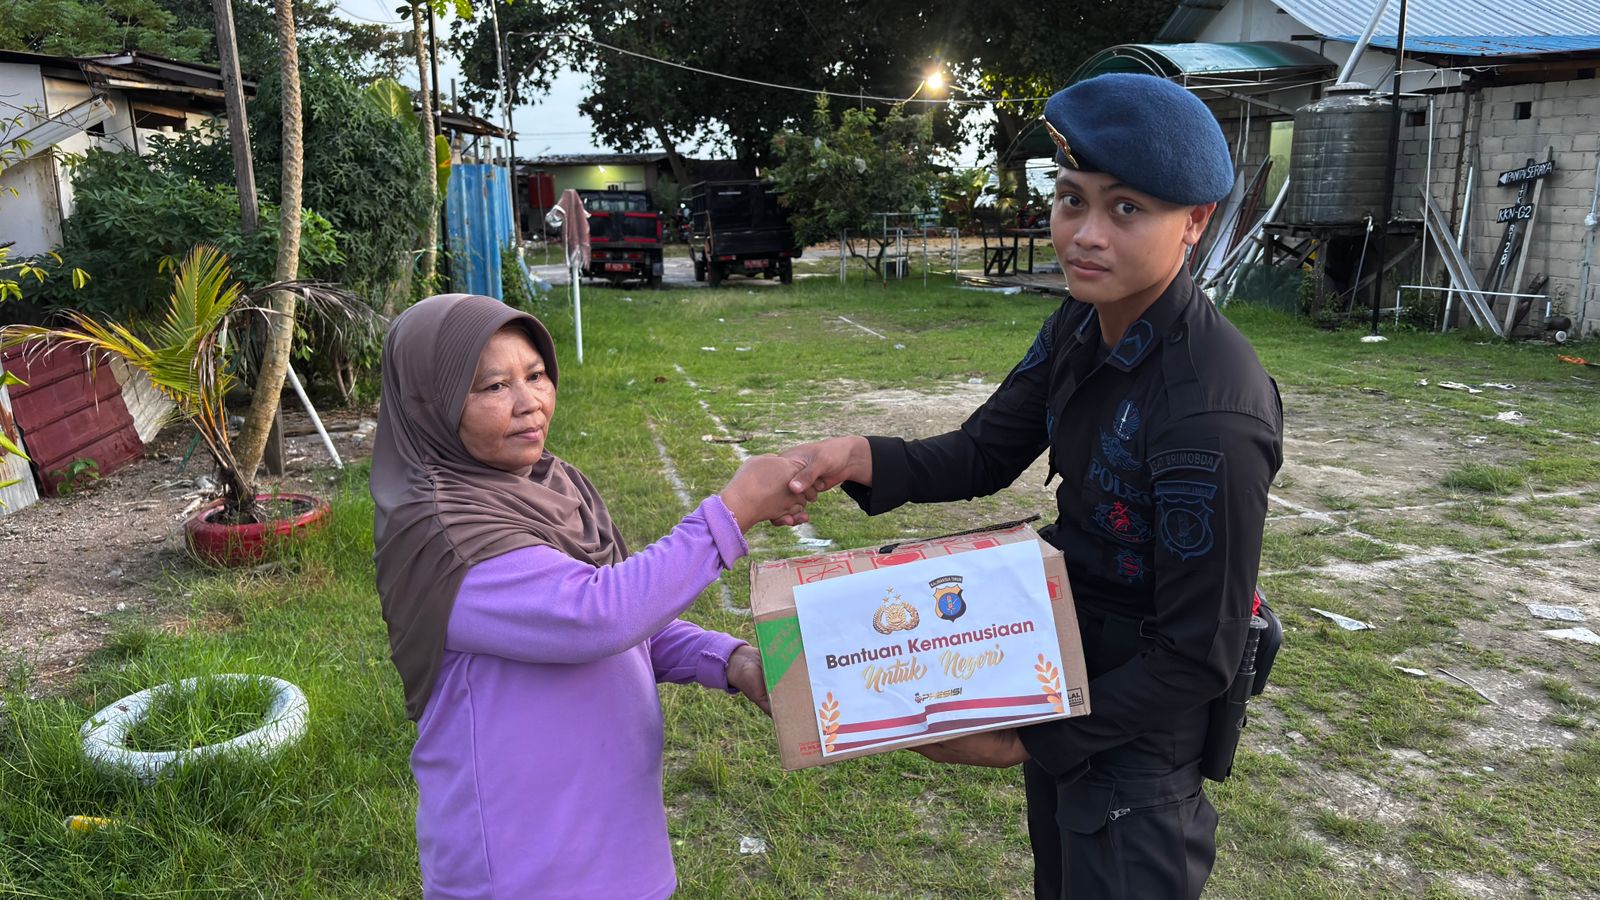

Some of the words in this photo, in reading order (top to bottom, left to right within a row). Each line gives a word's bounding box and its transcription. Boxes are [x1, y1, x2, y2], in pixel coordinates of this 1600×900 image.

[1526, 162, 1553, 179] SERAYA
[1498, 205, 1532, 221] KKN-G2
[826, 643, 903, 669] Bantuan
[907, 620, 1034, 653] Kemanusiaan
[861, 656, 928, 693] Untuk
[938, 643, 1005, 680] Negeri
